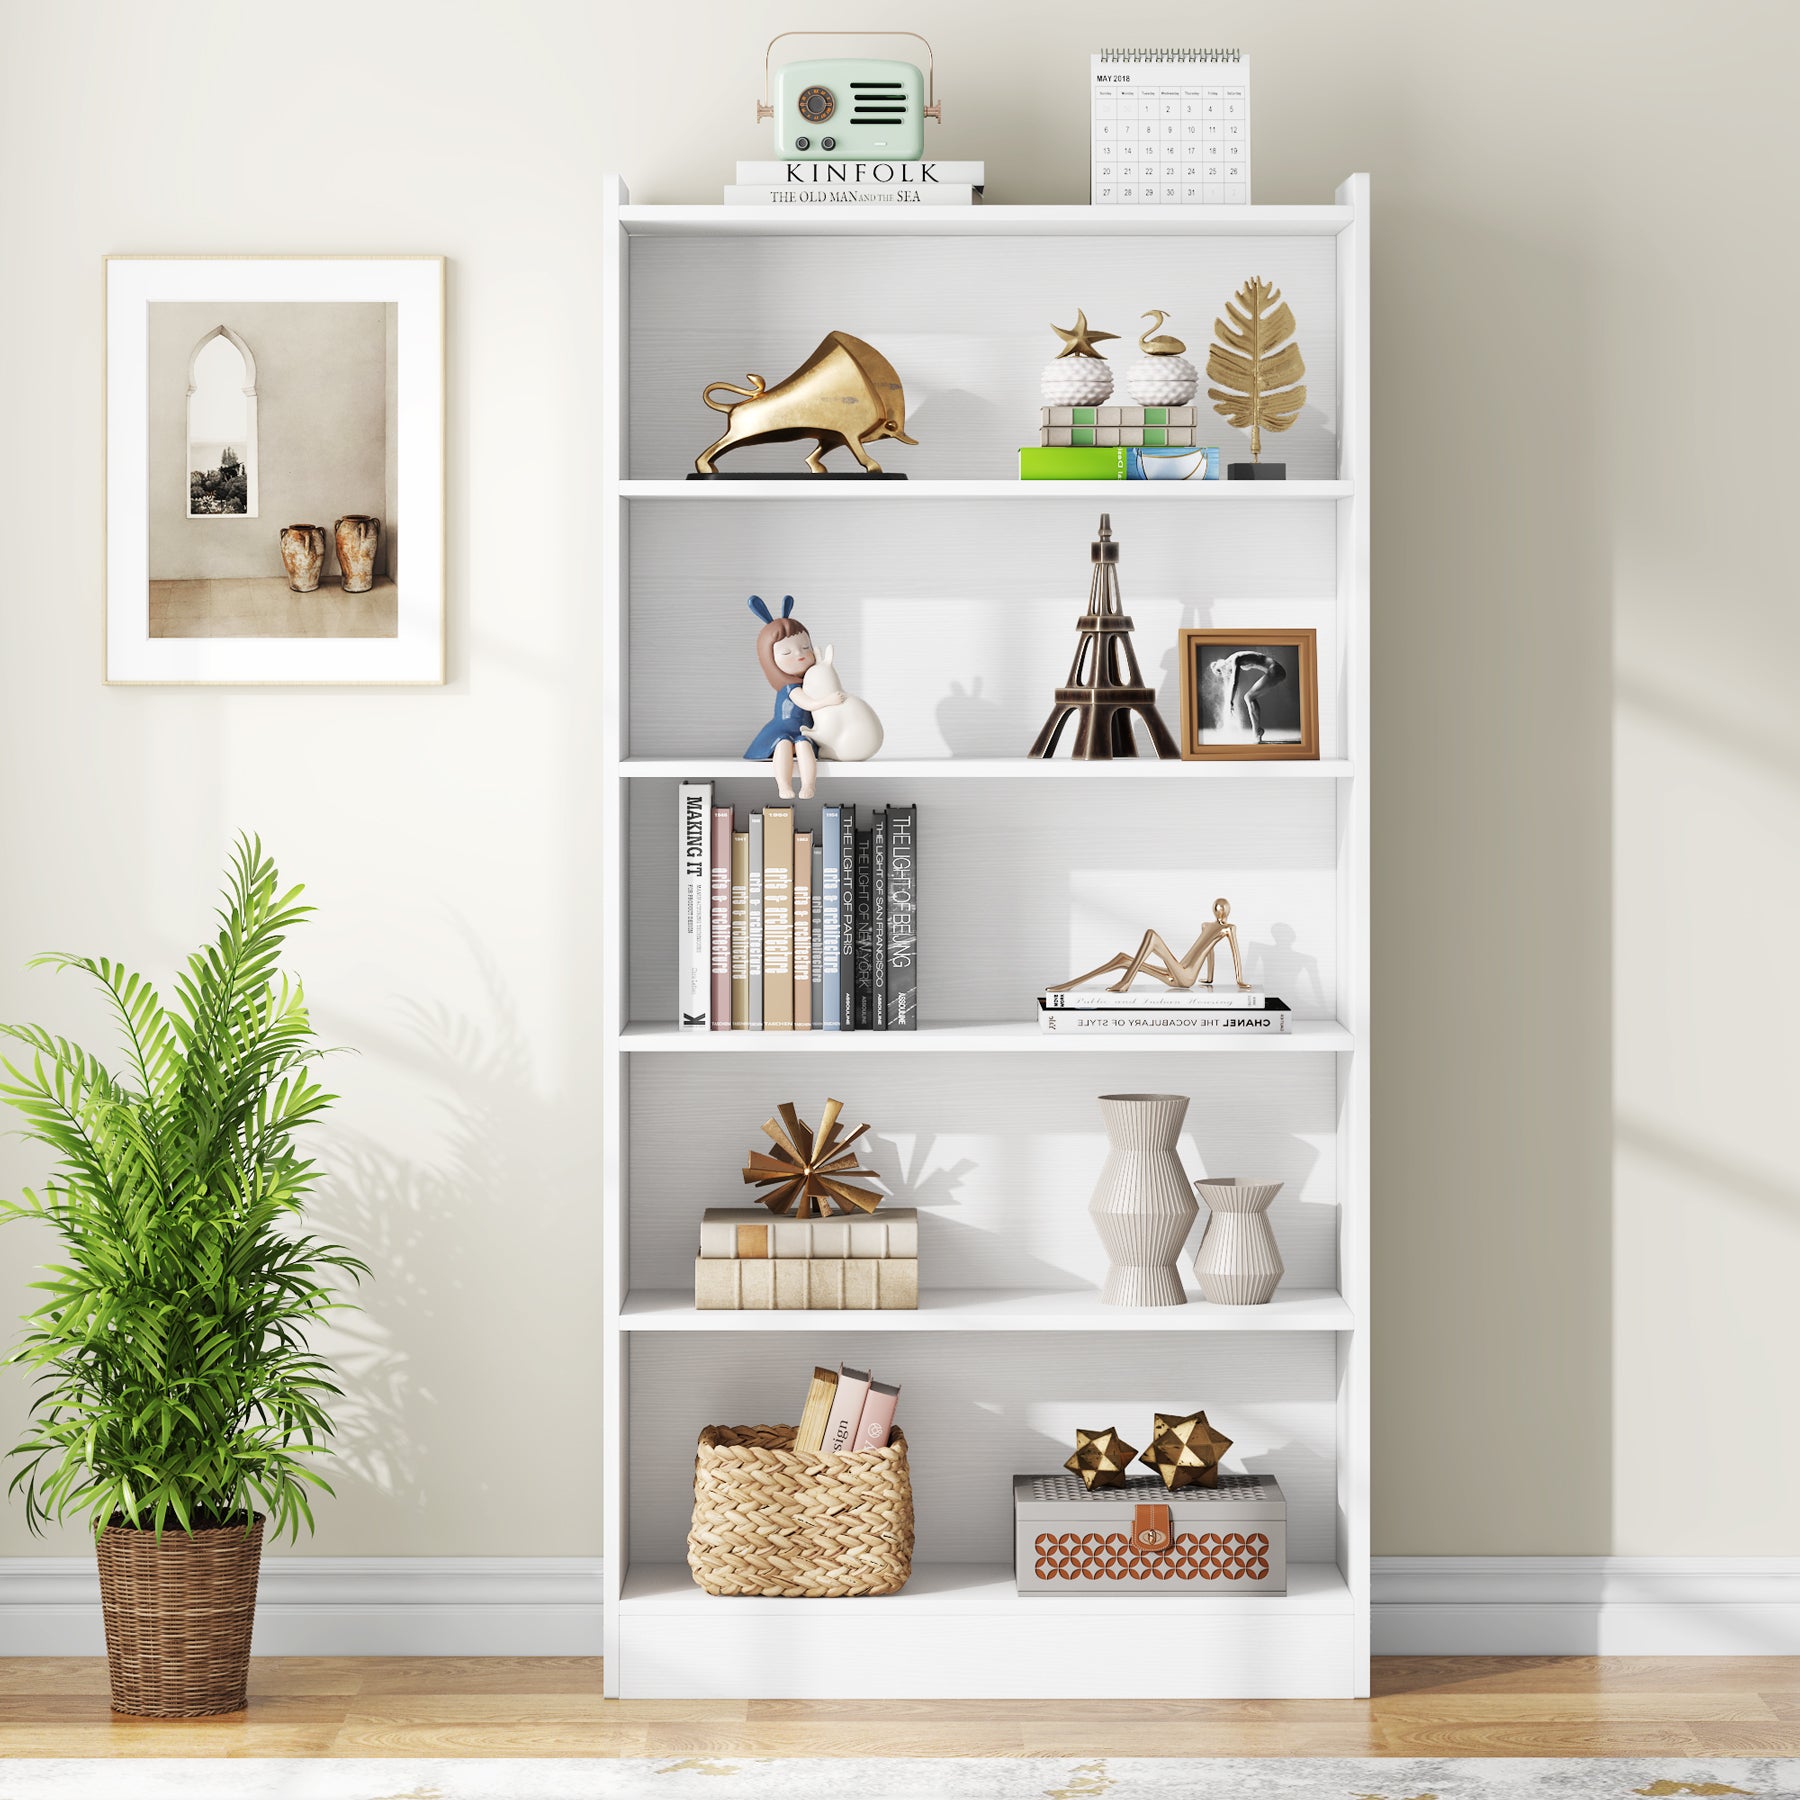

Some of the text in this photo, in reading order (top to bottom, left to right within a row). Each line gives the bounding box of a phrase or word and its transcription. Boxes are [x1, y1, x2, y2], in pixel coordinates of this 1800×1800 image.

[787, 163, 939, 183] KINFOLK
[770, 191, 796, 202] THE
[799, 191, 826, 202] OLD
[830, 191, 858, 202] MAN
[896, 190, 920, 202] SEA
[687, 796, 702, 876] MAKING IT
[712, 868, 731, 888] arts
[750, 872, 762, 892] arts
[765, 868, 793, 888] arts
[824, 868, 840, 888] arts
[844, 816, 852, 955] THE LIGHT OF PARIS
[876, 879, 883, 895] OF
[732, 886, 748, 904] arts
[794, 886, 810, 905] arts
[893, 816, 910, 968] THE LIGHT OF BEIJING
[859, 840, 869, 988] THE LIGHT OF NEW YORK
[712, 908, 731, 973] architecture
[765, 908, 793, 973] architecture
[824, 908, 840, 973] architecture
[683, 1012, 706, 1026] K
[833, 1420, 848, 1453] sign
